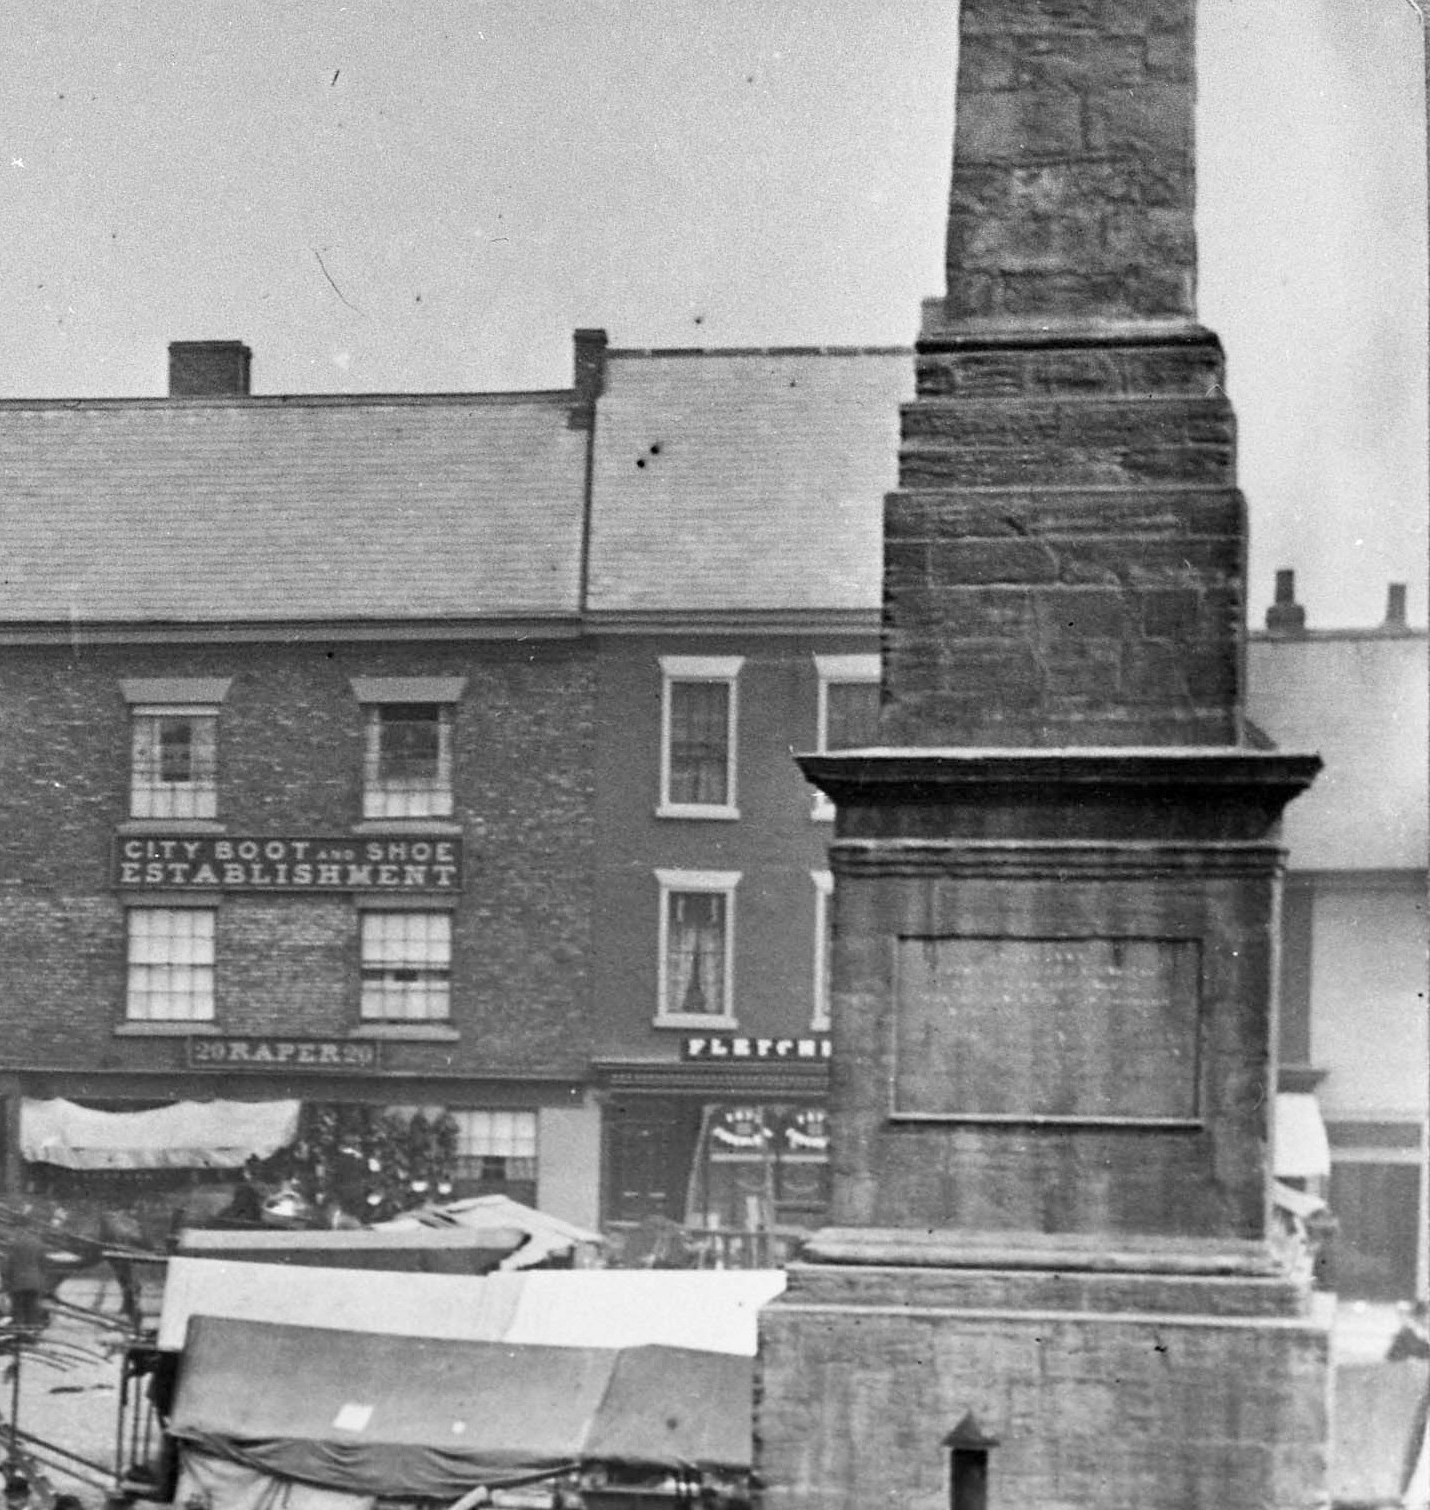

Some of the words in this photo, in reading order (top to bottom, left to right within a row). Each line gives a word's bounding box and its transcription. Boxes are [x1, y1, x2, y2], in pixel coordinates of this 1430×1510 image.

[124, 841, 202, 859] CITY
[214, 841, 310, 860] BOOT
[316, 849, 355, 861] AND
[366, 842, 454, 861] SHOE
[121, 863, 456, 886] ESTABLISHMENT
[195, 1042, 226, 1061] 20
[227, 1042, 341, 1063] RAPER
[343, 1043, 373, 1063] 20
